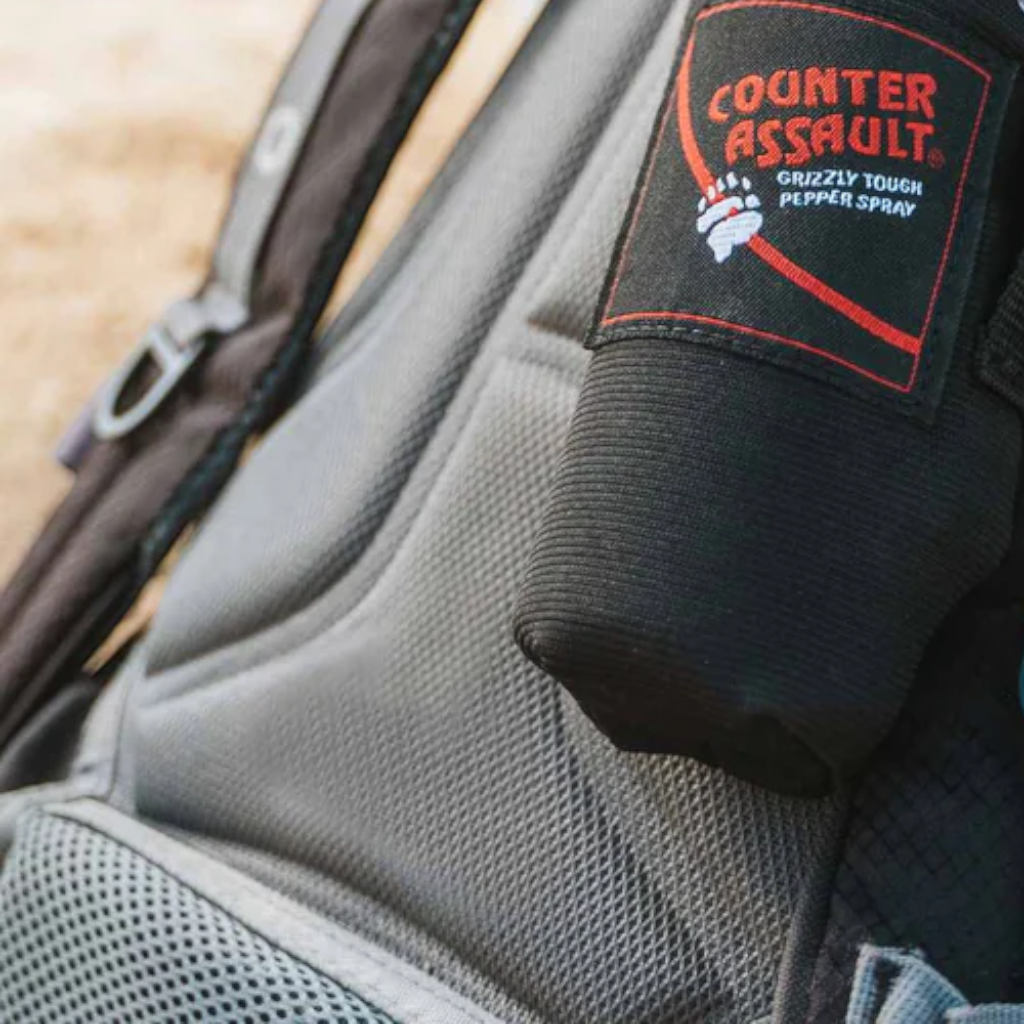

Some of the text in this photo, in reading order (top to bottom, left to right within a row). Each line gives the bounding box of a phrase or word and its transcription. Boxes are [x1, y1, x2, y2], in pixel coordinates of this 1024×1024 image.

[708, 65, 938, 123] COUNTER
[776, 169, 924, 196] GRIZZLY TOUGH
[779, 190, 917, 218] PEPPER SPRAY
